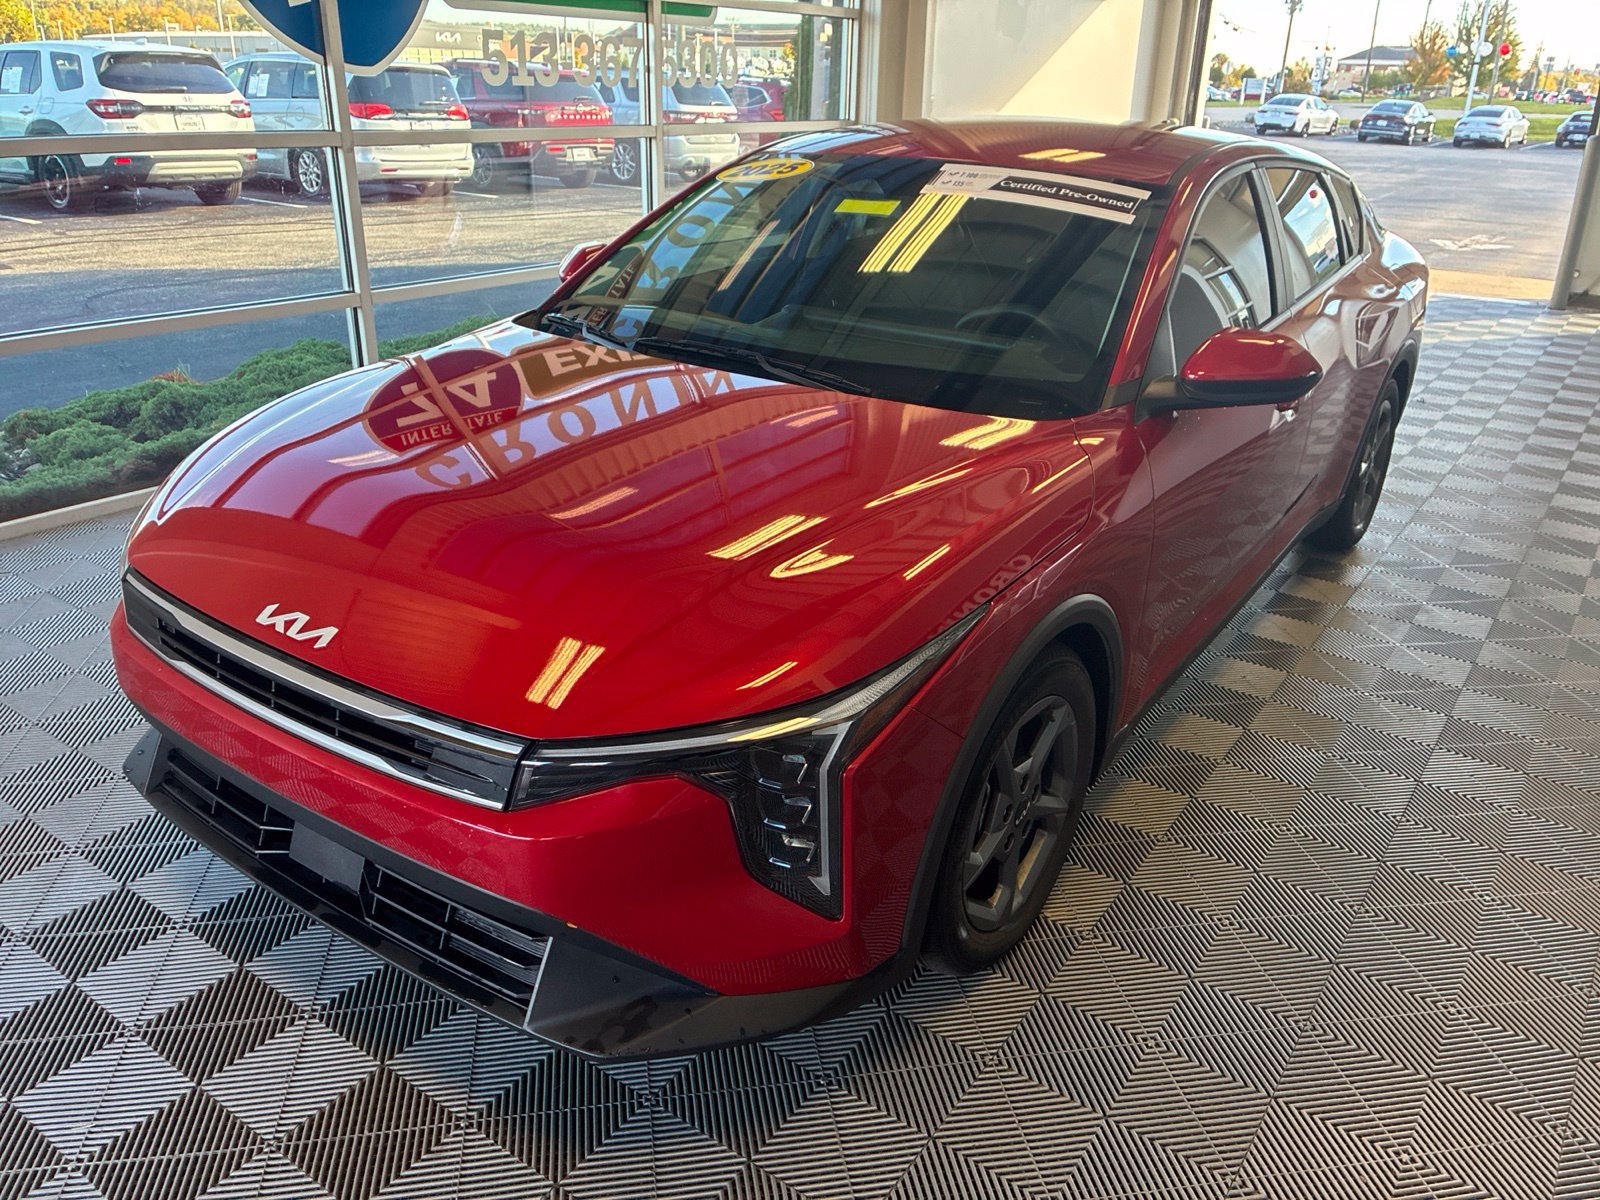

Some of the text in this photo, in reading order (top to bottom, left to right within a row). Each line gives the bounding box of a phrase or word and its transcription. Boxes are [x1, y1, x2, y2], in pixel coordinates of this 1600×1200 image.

[481, 28, 738, 89] 513-3675300
[724, 162, 808, 179] 2025
[1000, 180, 1135, 209] Certified Pre-Owned
[255, 603, 339, 649] KIA
